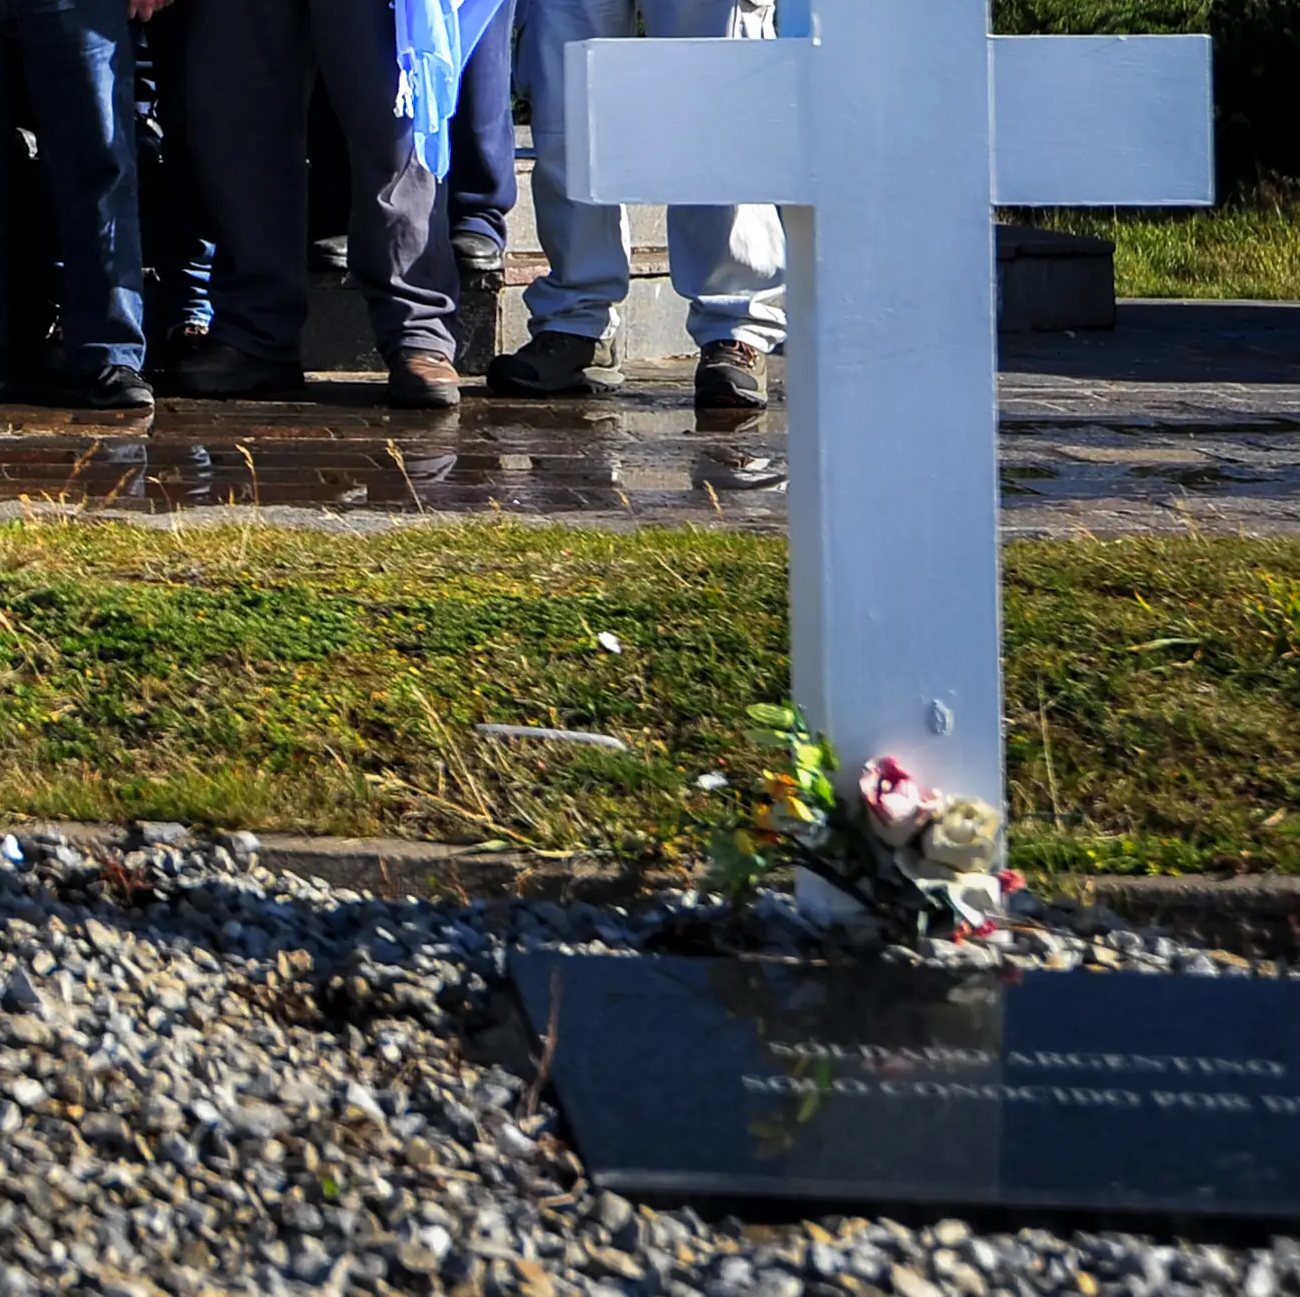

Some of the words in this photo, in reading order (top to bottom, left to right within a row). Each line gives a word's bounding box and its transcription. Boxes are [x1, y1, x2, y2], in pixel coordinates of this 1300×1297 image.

[1005, 1050, 1286, 1078] ARGENTINO
[878, 1080, 1142, 1108] CONOCIDO
[1149, 1090, 1251, 1110] POR
